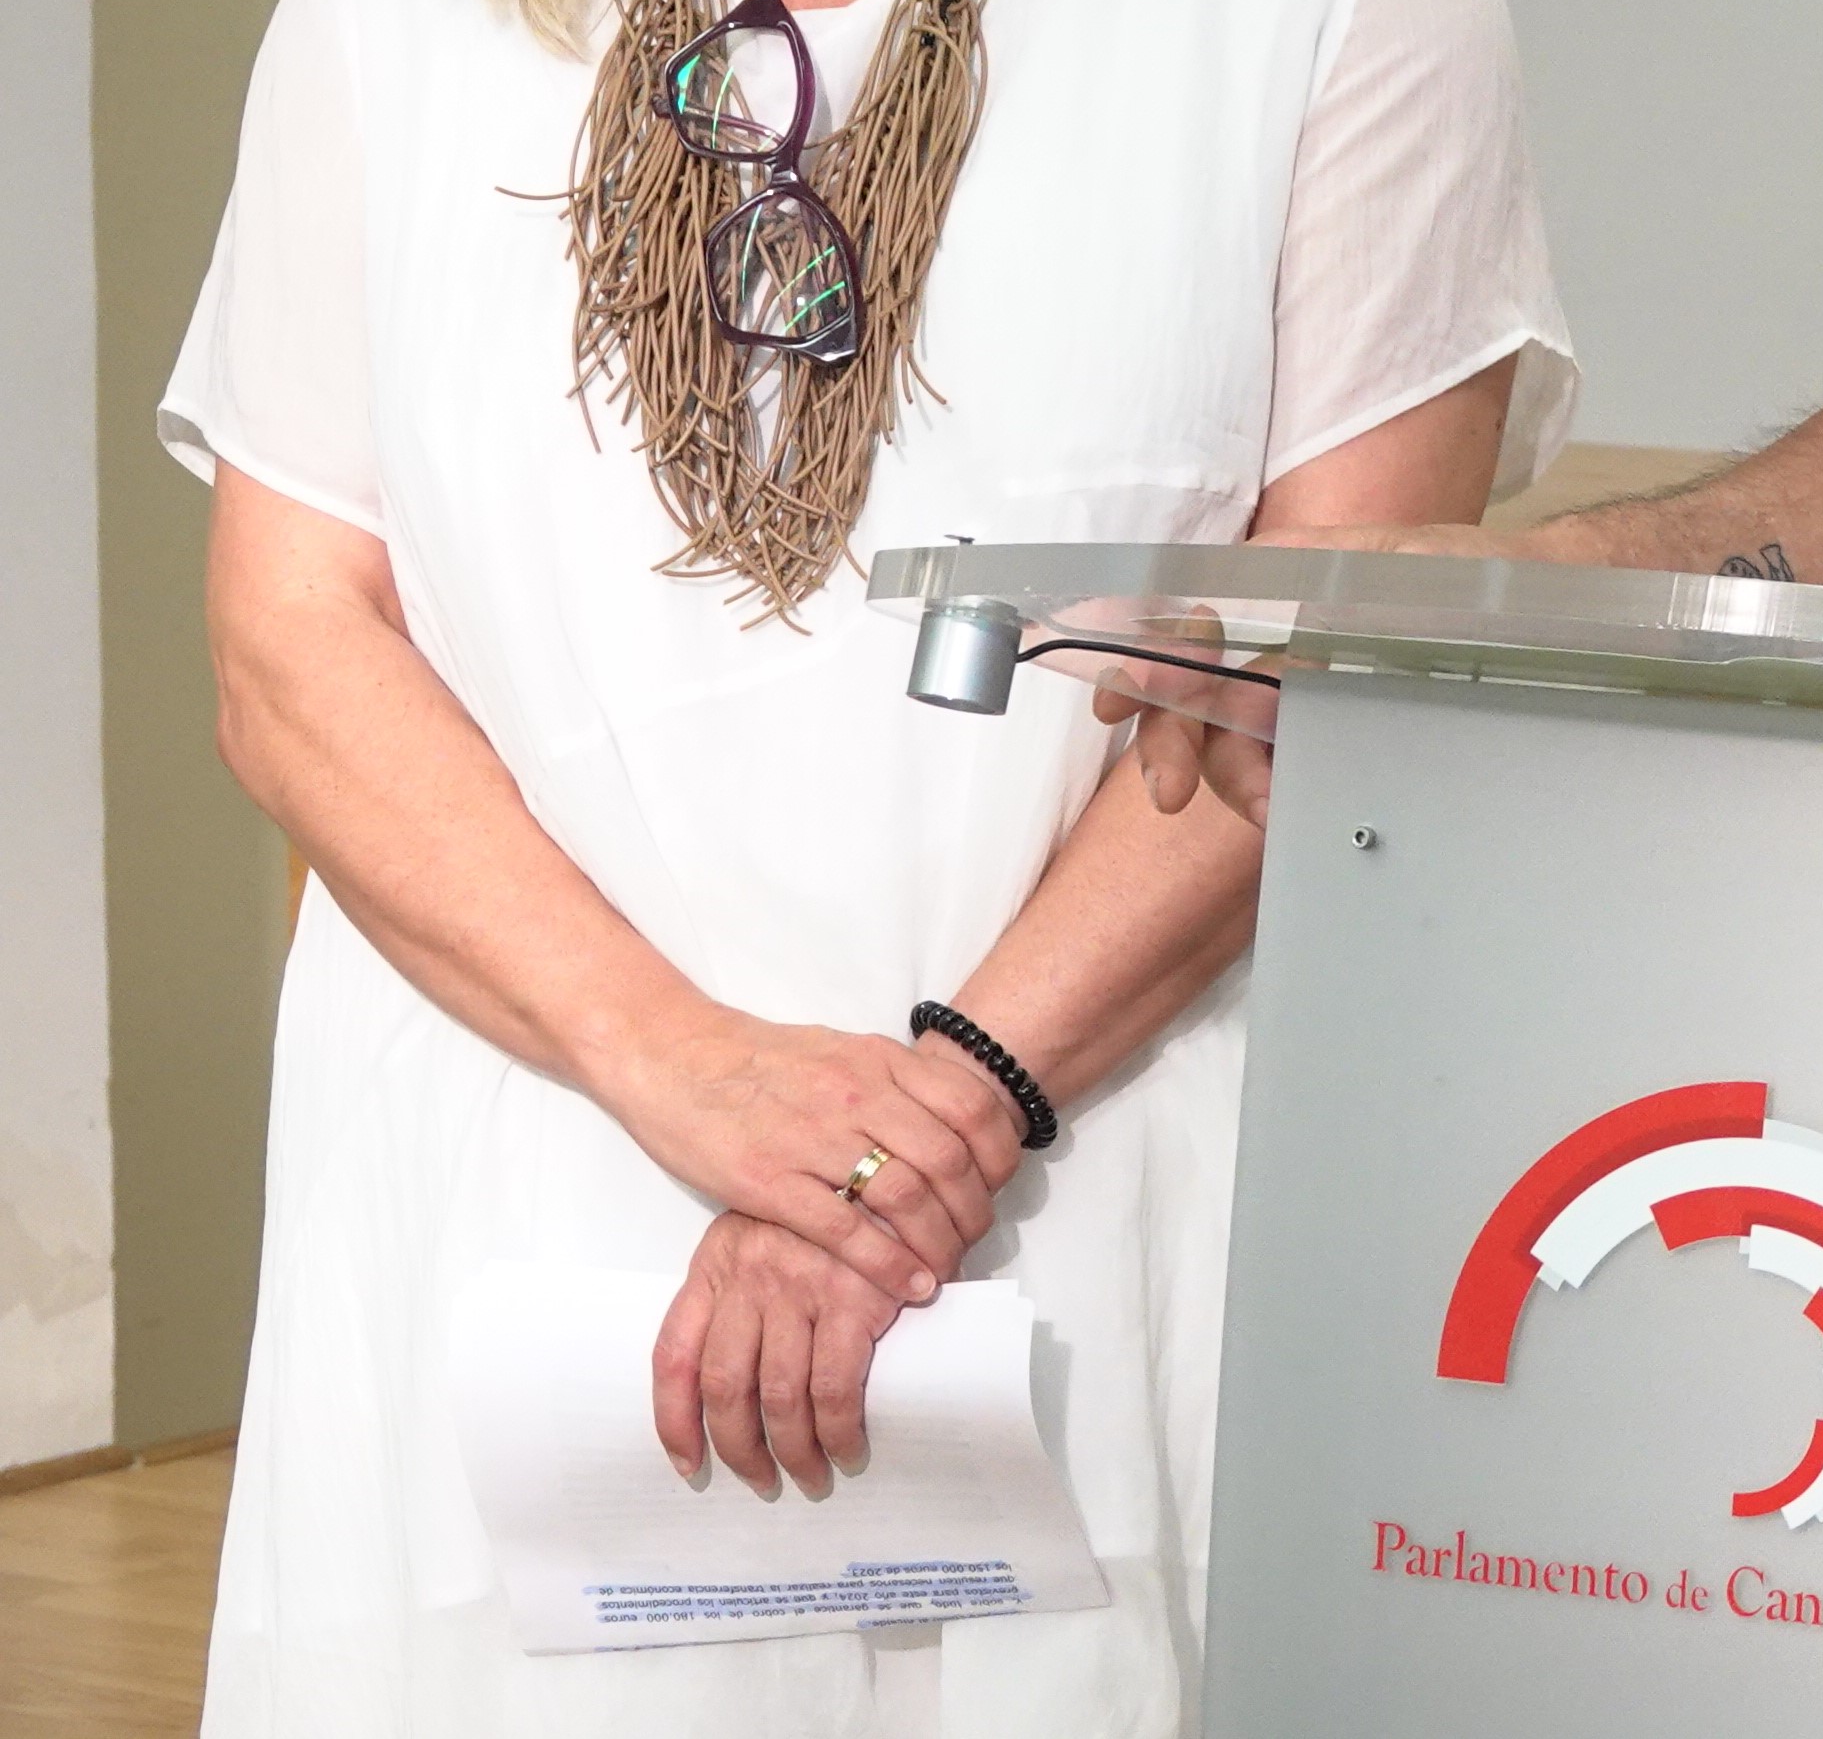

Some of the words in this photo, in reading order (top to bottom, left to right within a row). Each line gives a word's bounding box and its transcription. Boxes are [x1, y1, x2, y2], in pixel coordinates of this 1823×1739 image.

[886, 1566, 900, 1576] de
[1371, 1519, 1651, 1606] Parlamento
[1663, 1570, 1711, 1614] de
[837, 1579, 864, 1589] para
[993, 1575, 1015, 1585] que
[599, 1587, 614, 1597] de
[687, 1584, 764, 1594] transferencia
[932, 1588, 959, 1598] para
[901, 1590, 927, 1600] este
[601, 1598, 692, 1611] procedimientos
[813, 1602, 869, 1614] garantice
[752, 1608, 786, 1618] cobro
[603, 1614, 638, 1623] euros
